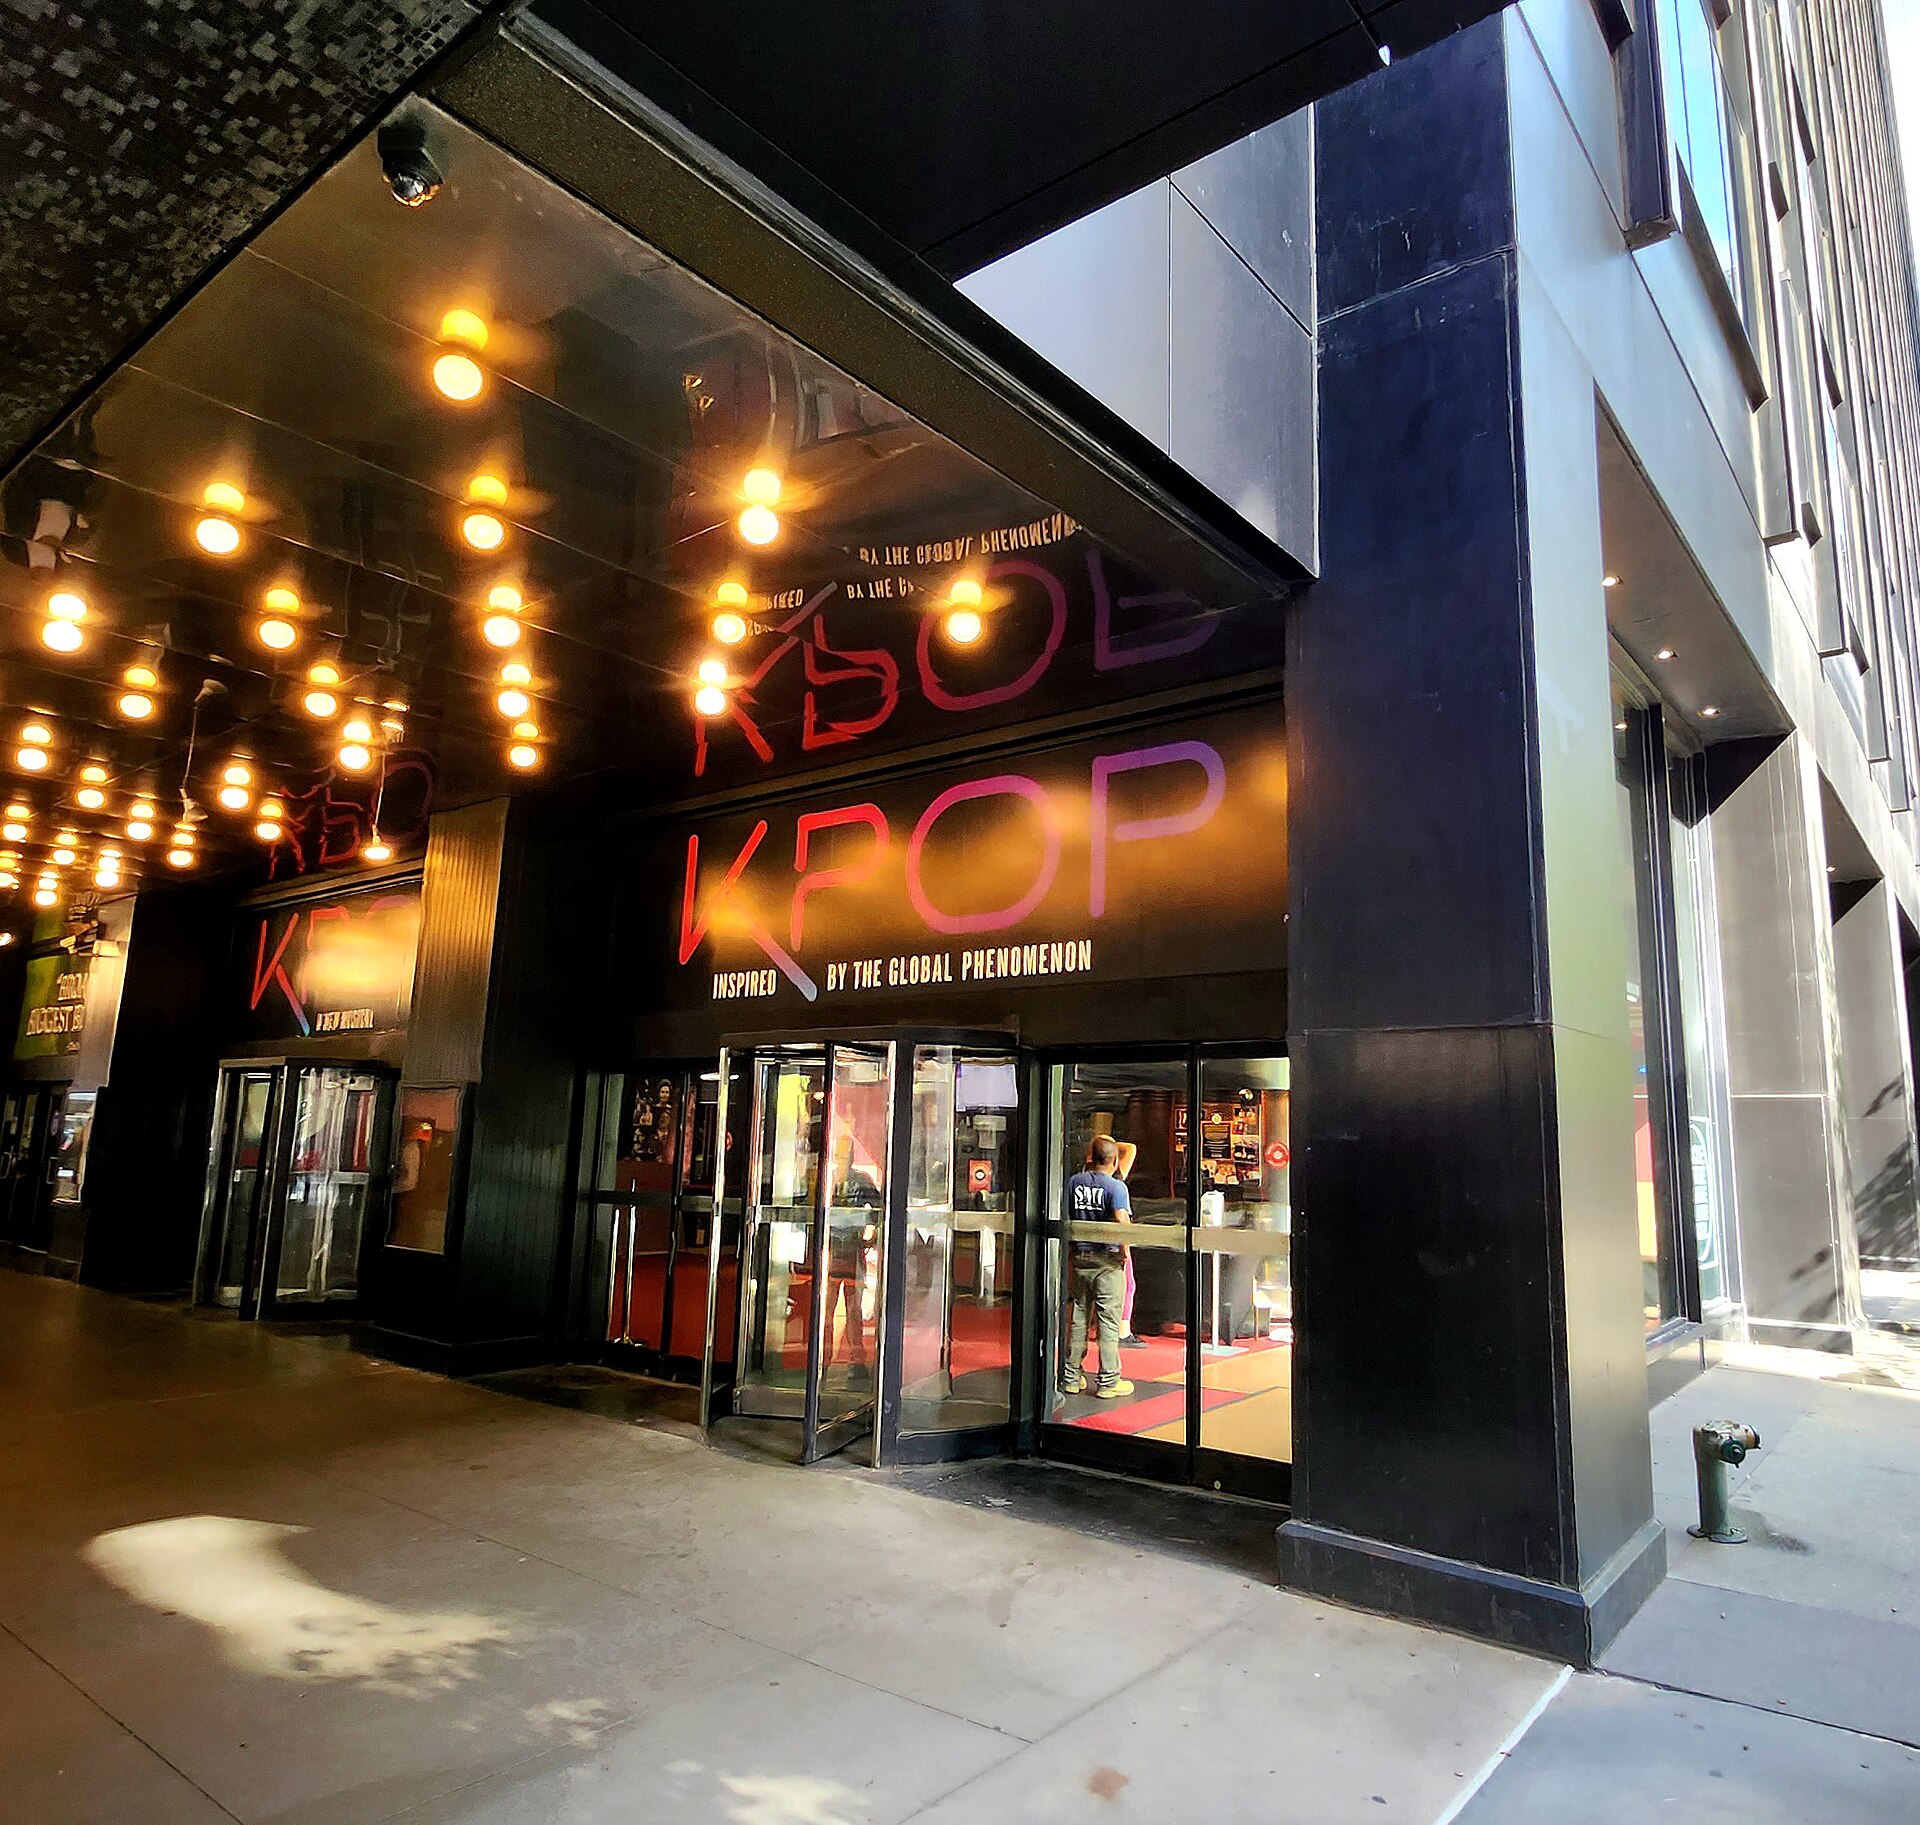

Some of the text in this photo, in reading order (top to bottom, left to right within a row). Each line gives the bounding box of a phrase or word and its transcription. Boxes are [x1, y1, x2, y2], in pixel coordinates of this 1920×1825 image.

[679, 740, 1227, 1001] KPOP
[712, 939, 1092, 1000] INSPIRED BY THE GLOBAL PHENOMENON
